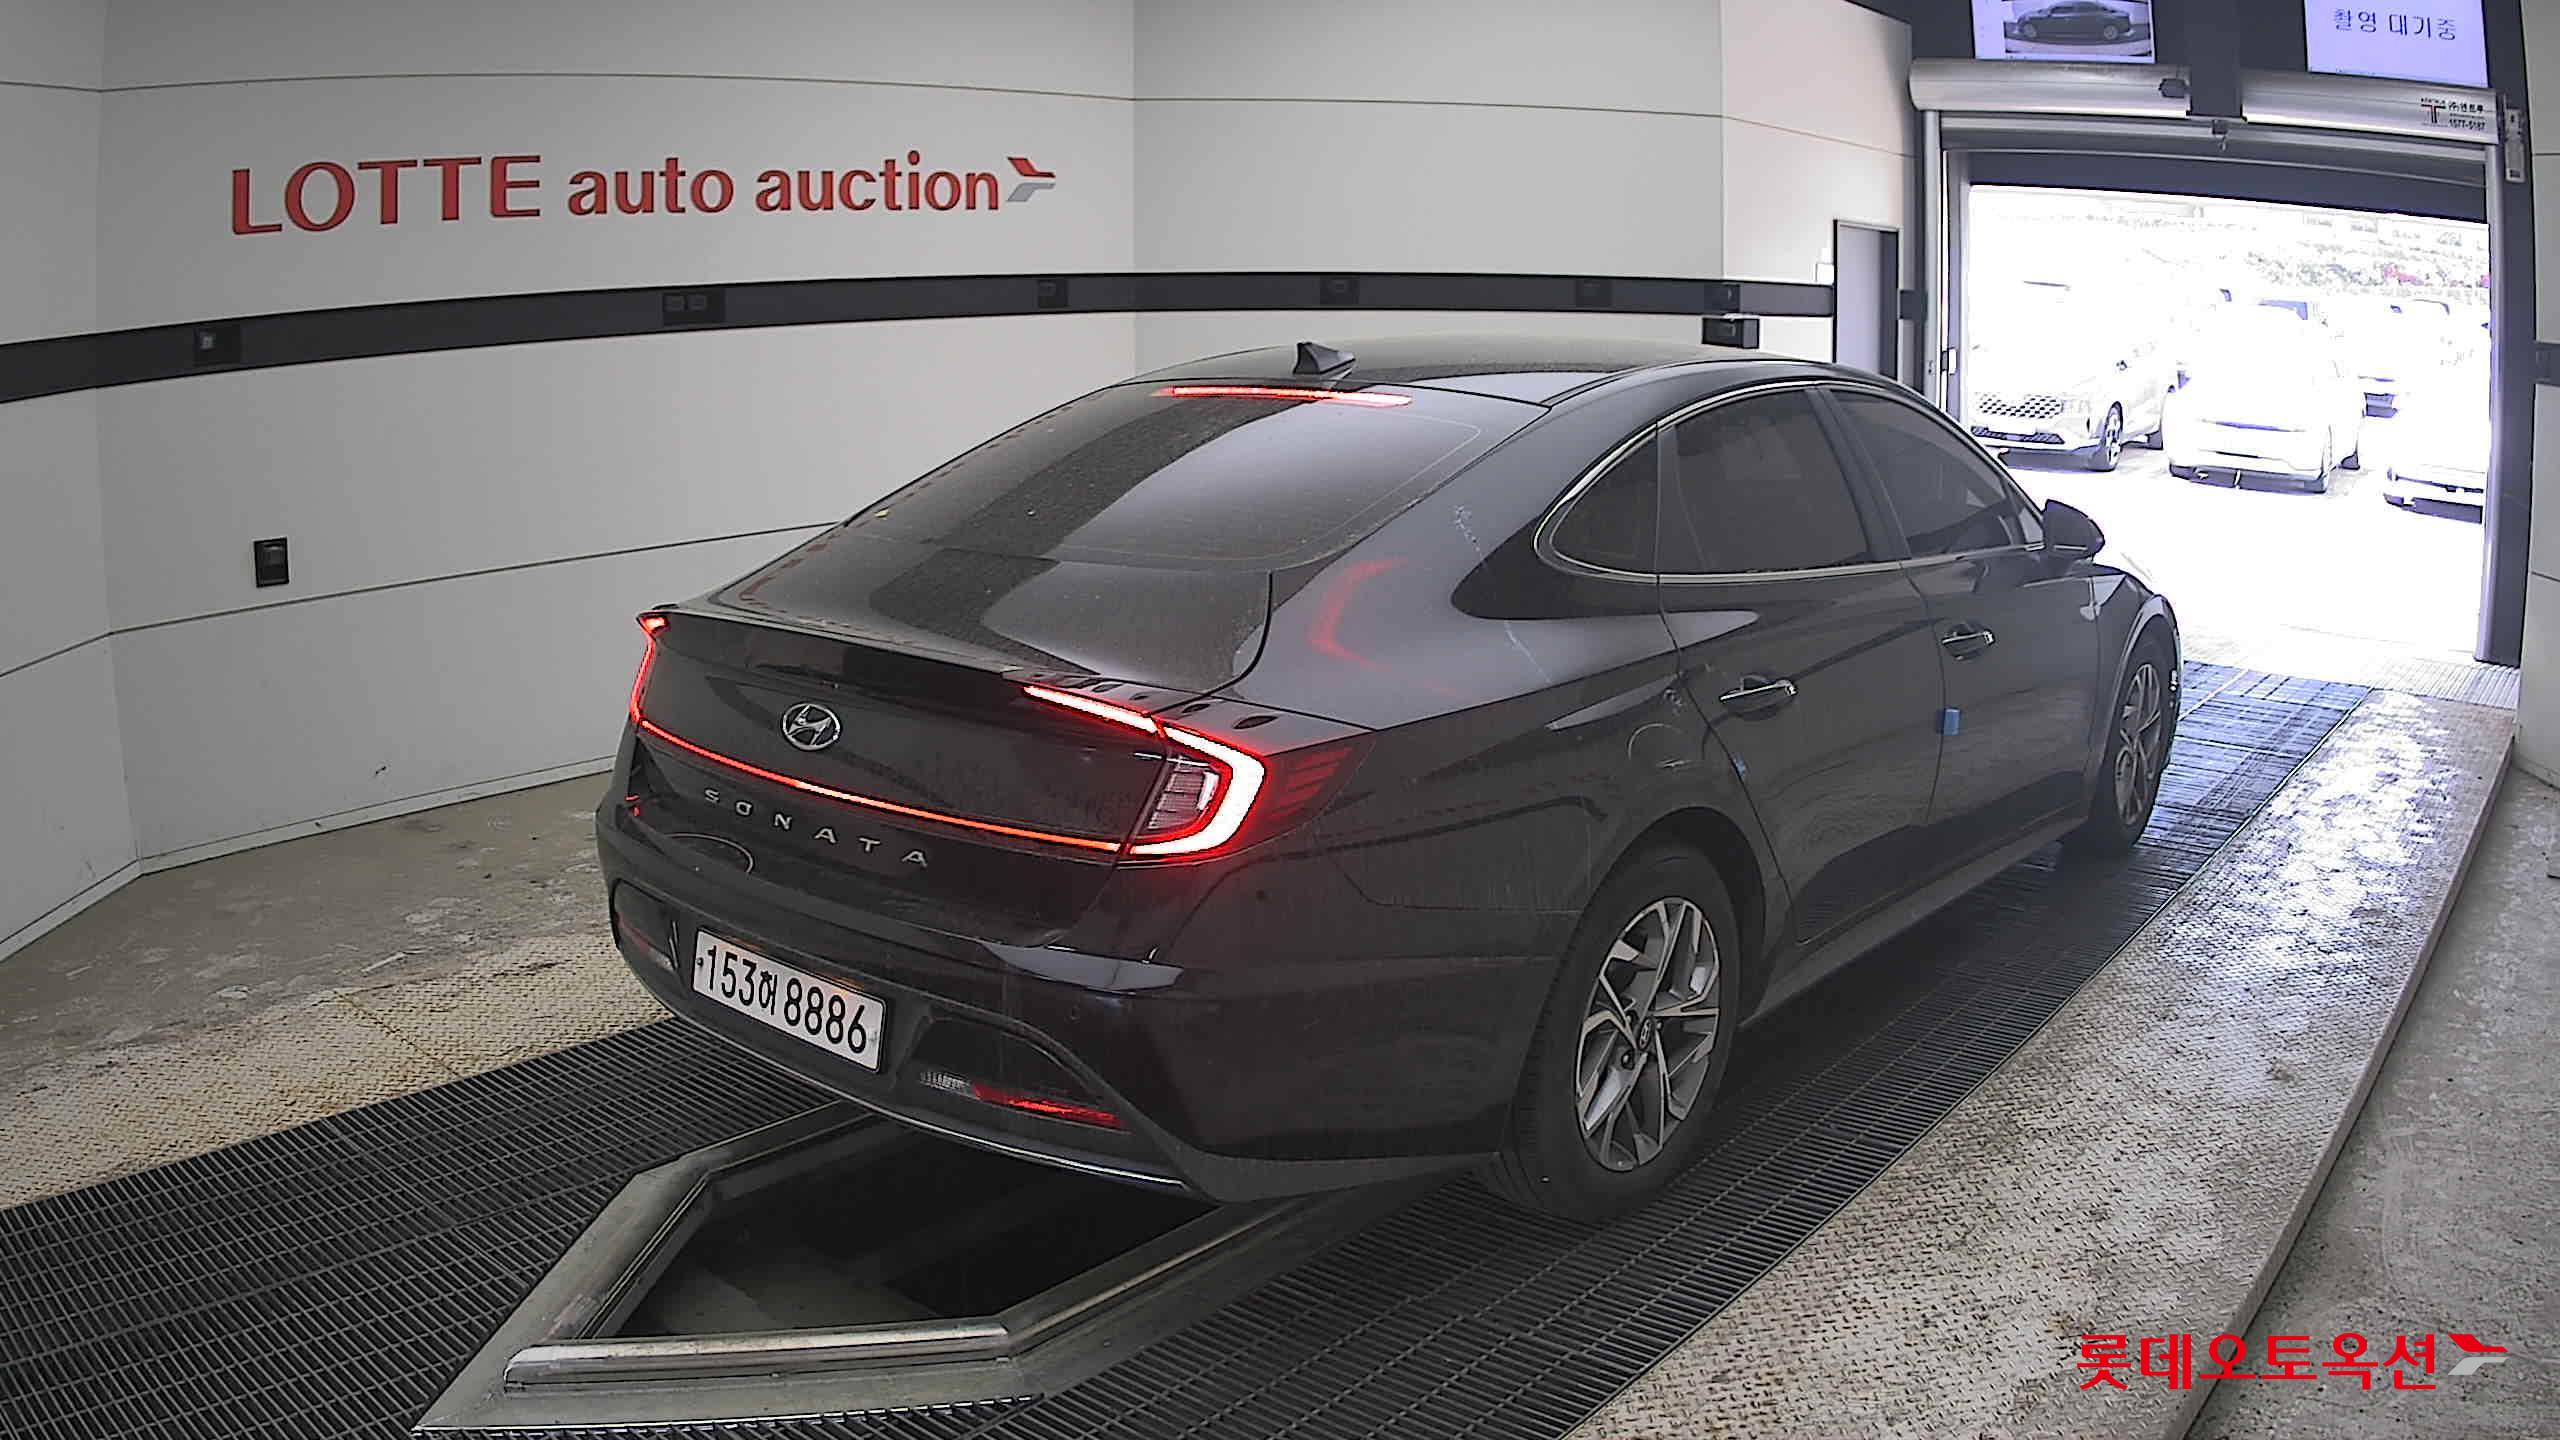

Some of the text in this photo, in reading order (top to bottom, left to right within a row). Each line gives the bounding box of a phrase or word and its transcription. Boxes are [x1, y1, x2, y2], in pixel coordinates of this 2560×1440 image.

[2334, 8, 2456, 41] 촬영 대기중
[231, 149, 1001, 235] LOTTE auto auction
[704, 787, 929, 868] SONATA
